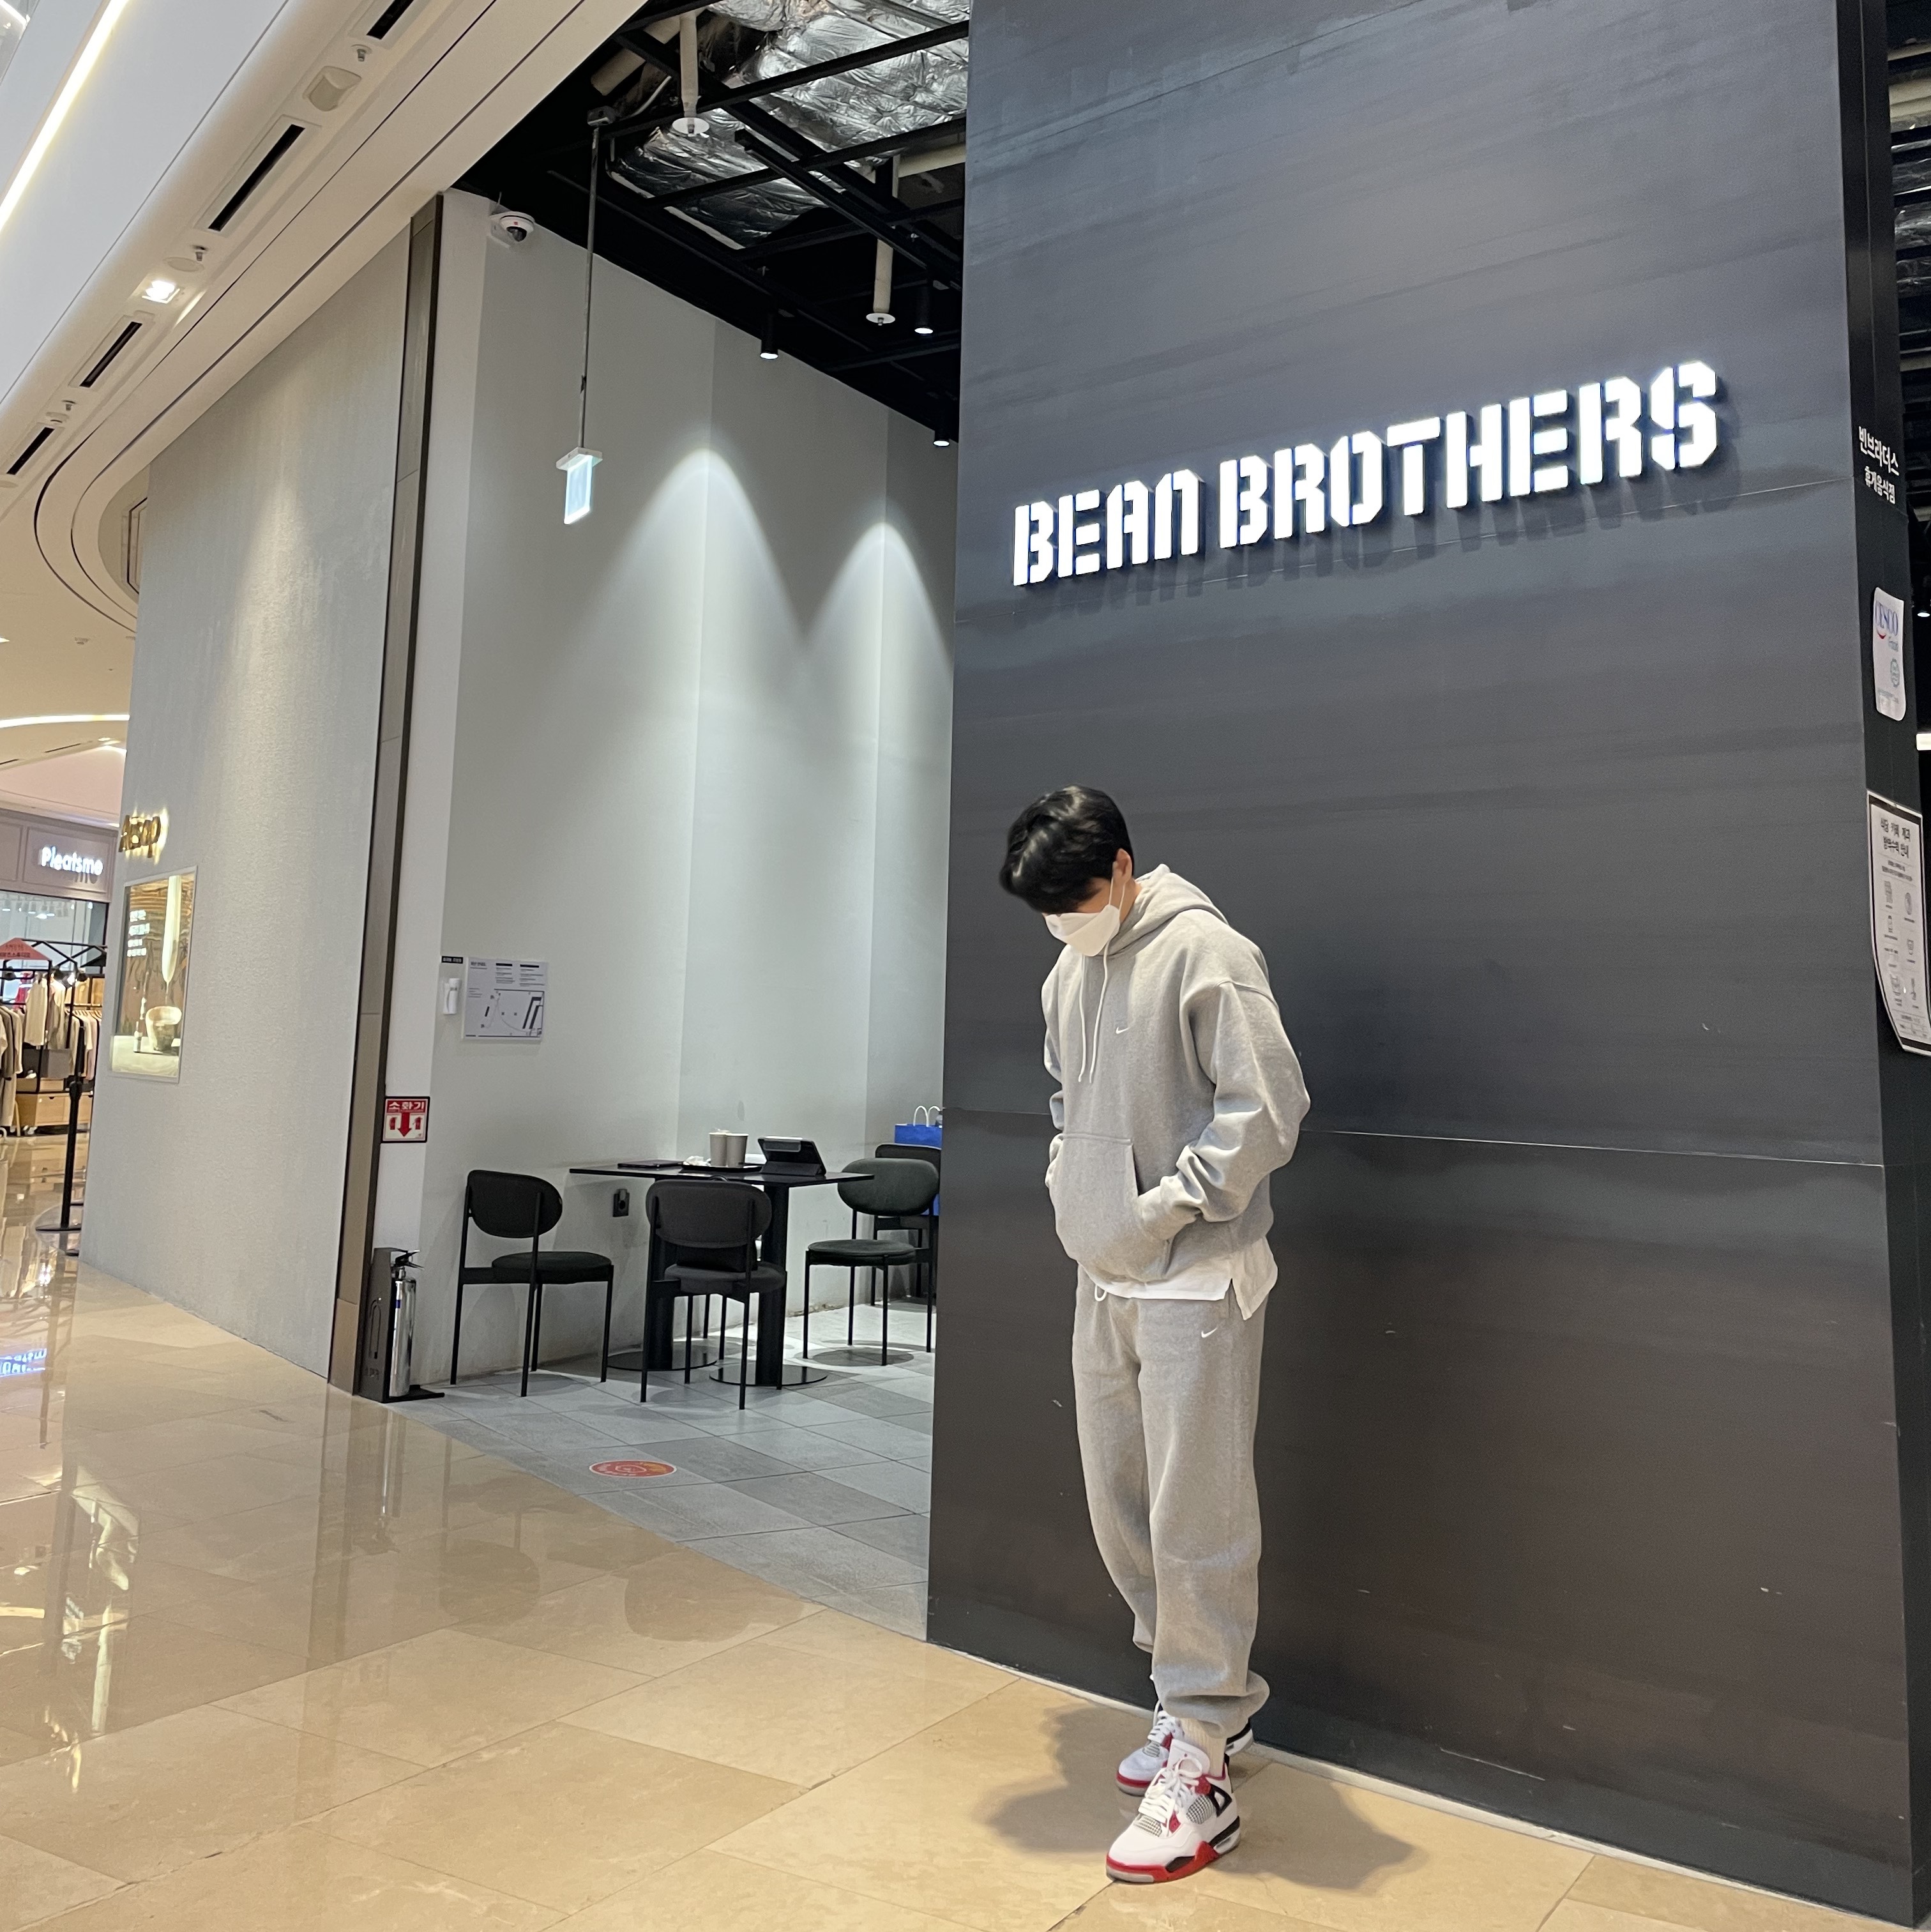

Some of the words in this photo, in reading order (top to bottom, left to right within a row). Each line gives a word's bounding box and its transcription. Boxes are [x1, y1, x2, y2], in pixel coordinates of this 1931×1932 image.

[1859, 426, 1900, 476] 빈브라더스
[1013, 469, 1198, 586] BEAN
[1220, 361, 1716, 548] BROTHERS
[1865, 466, 1895, 504] 휴게음식점
[388, 1101, 425, 1110] 소화기
